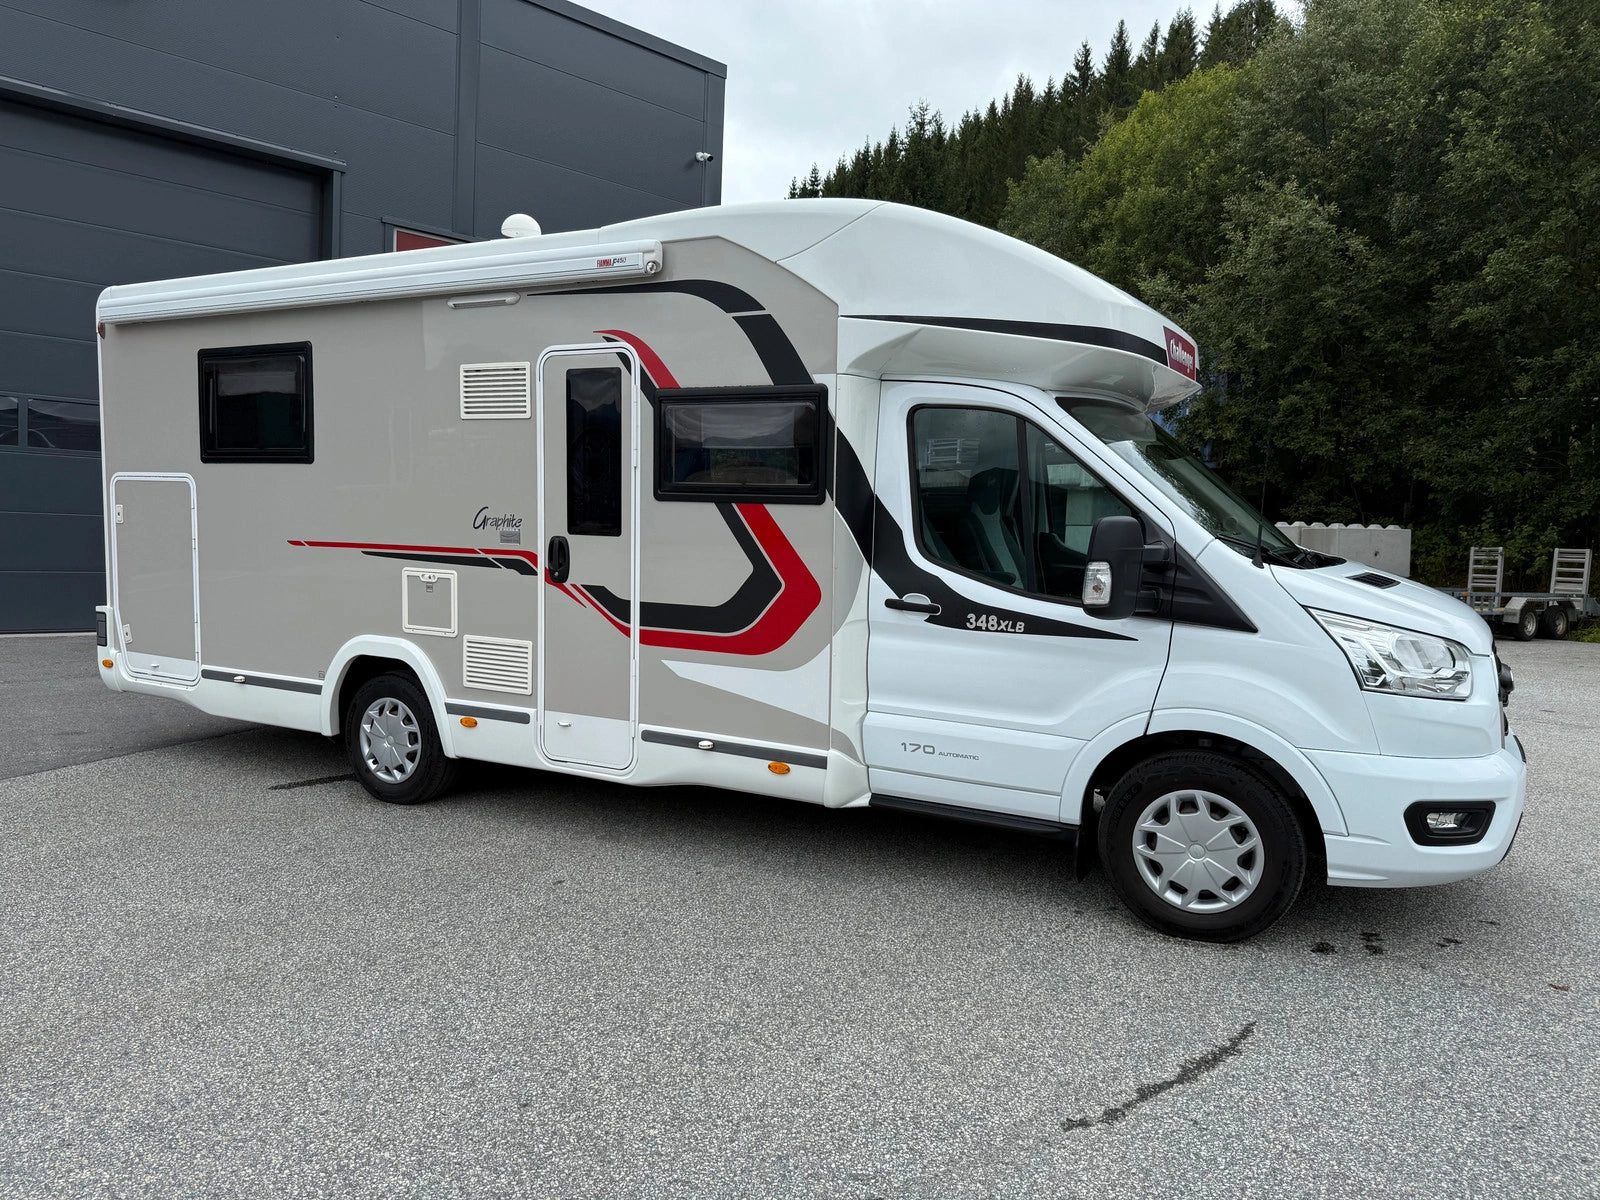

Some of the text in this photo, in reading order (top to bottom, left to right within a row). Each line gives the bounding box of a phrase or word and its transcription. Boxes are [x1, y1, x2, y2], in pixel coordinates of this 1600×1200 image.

[472, 506, 523, 531] Graphite
[901, 742, 980, 761] 170 AUTOMATIC
